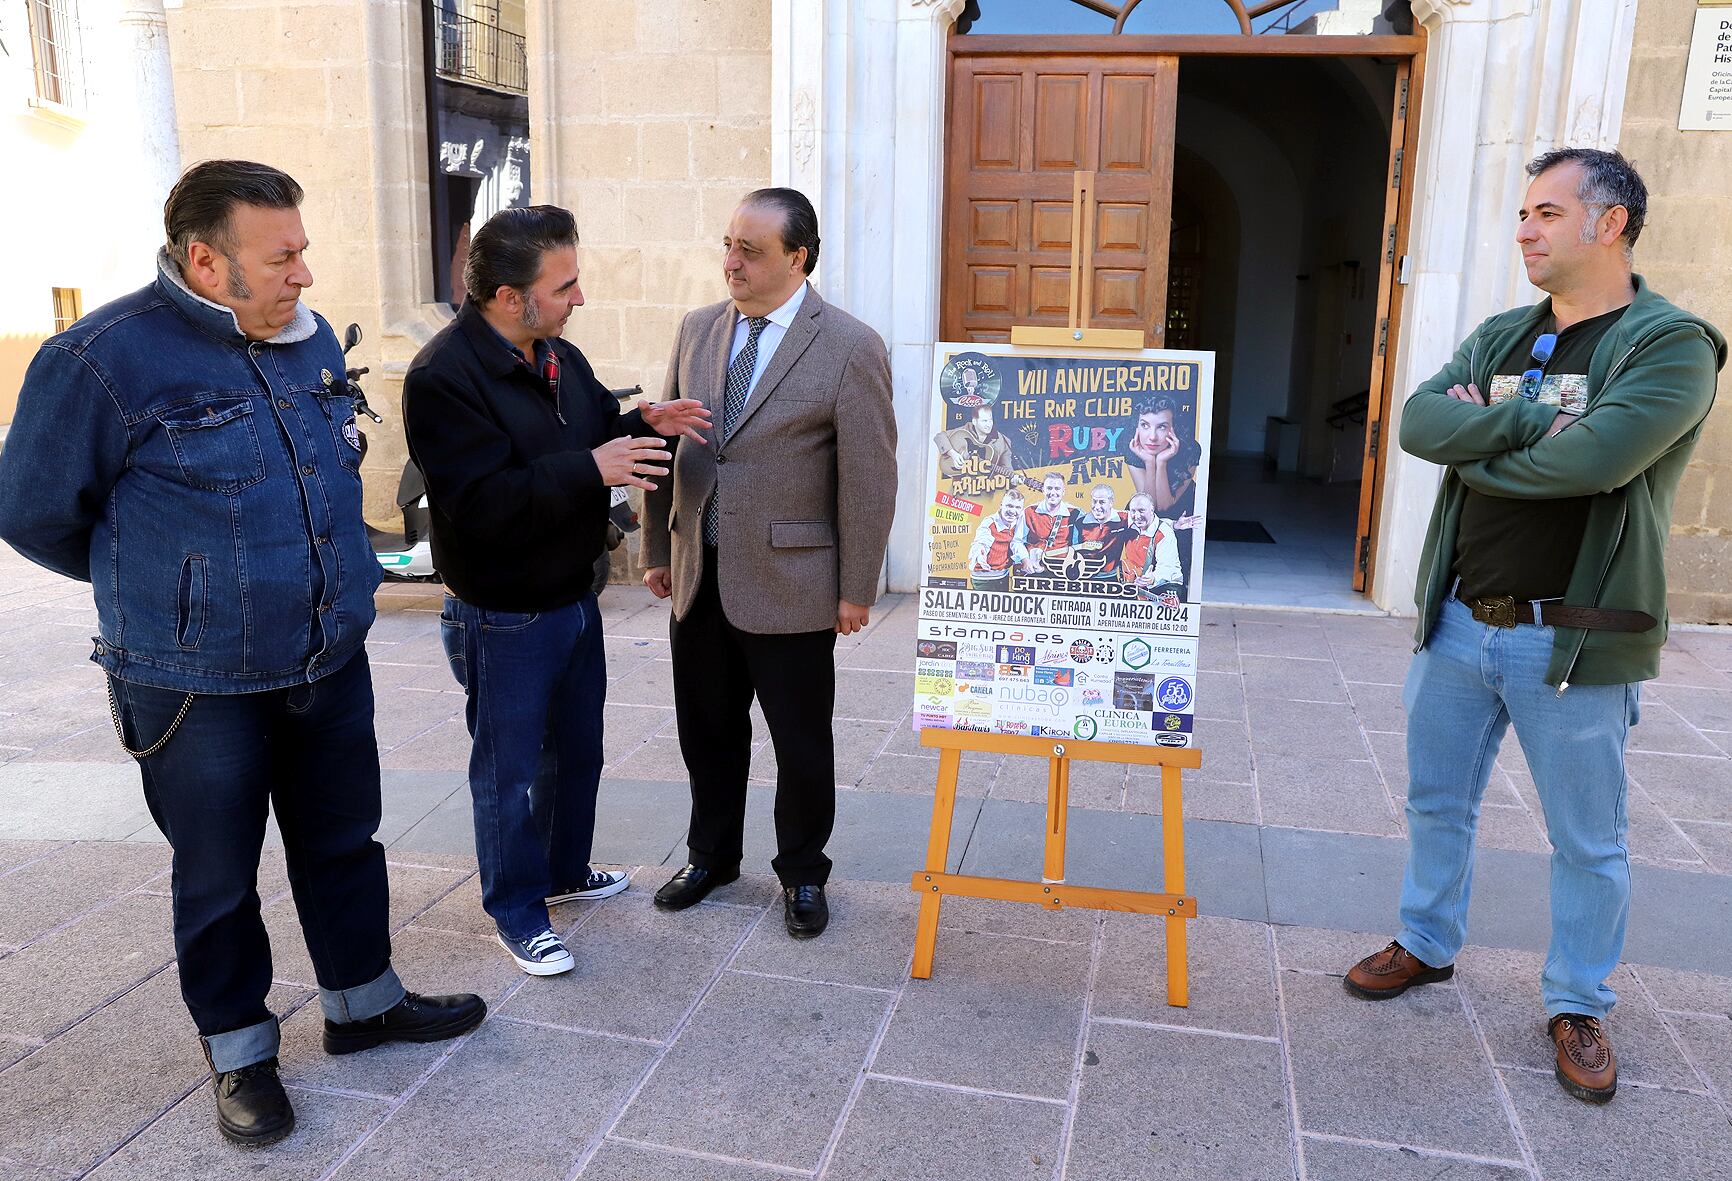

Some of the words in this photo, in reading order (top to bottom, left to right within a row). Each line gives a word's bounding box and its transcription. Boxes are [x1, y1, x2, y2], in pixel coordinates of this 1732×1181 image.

[1717, 32, 1731, 41] de
[1714, 54, 1732, 63] His
[1017, 368, 1048, 396] VIII
[1053, 364, 1192, 395] ANIVERSARIO
[1001, 399, 1037, 420] THE
[1084, 396, 1133, 418] CLUB
[1182, 404, 1190, 412] PT
[955, 412, 963, 420] ES
[1048, 423, 1125, 459] RUBY
[1067, 455, 1127, 486] ANN
[952, 474, 1011, 497] ARLANDI
[1075, 491, 1084, 499] UK
[945, 510, 965, 522] LEWIS
[942, 525, 957, 534] WILD
[1012, 577, 1138, 598] FIREBIRDS
[924, 590, 965, 610] SALA
[970, 592, 1046, 616] PADDOCK
[1051, 599, 1092, 613] ENTRADA
[923, 609, 938, 617] PASEO
[938, 610, 945, 618] DE
[992, 614, 1006, 622] JEREZ
[1014, 615, 1021, 623] LA
[1021, 616, 1046, 624] FRONTERA
[1099, 602, 1107, 617] 9
[1110, 602, 1153, 620] MARZO
[1156, 605, 1189, 622] 2024
[1050, 613, 1092, 627] GRATUITA
[1097, 619, 1126, 628] APERTURA
[1131, 621, 1151, 630] PARTIR
[1151, 622, 1159, 630] DE
[1160, 623, 1171, 631] LAS
[1172, 624, 1188, 632] 12:00
[929, 624, 1064, 645] stampa.es
[1154, 646, 1191, 655] FERRETERIA
[1012, 652, 1031, 665] king
[1165, 681, 1185, 698] 55
[920, 703, 949, 712] newcar
[1094, 709, 1140, 721] CLINICA
[1104, 718, 1148, 730] EUROPA
